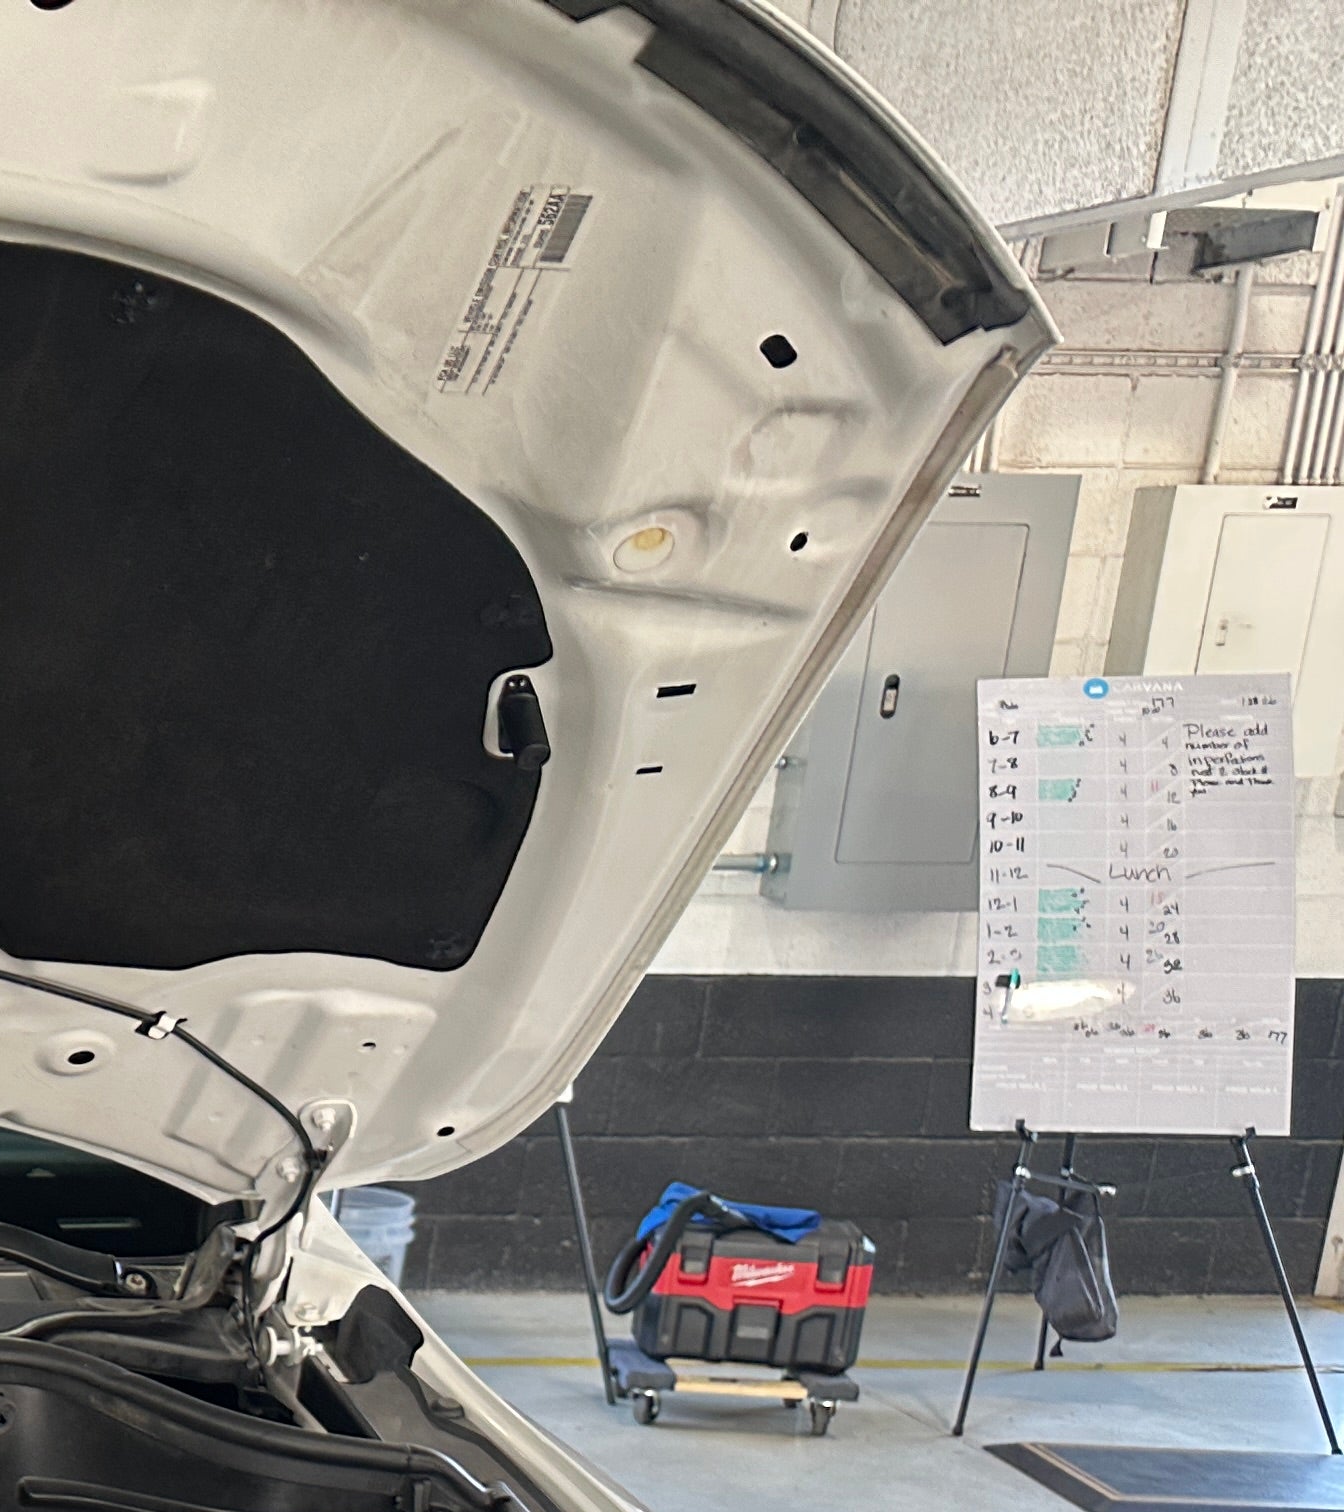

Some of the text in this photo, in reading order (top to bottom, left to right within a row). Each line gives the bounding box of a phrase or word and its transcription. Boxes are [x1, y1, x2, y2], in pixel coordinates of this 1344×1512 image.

[1183, 722, 1268, 739] Please add
[1109, 863, 1172, 882] Lunch
